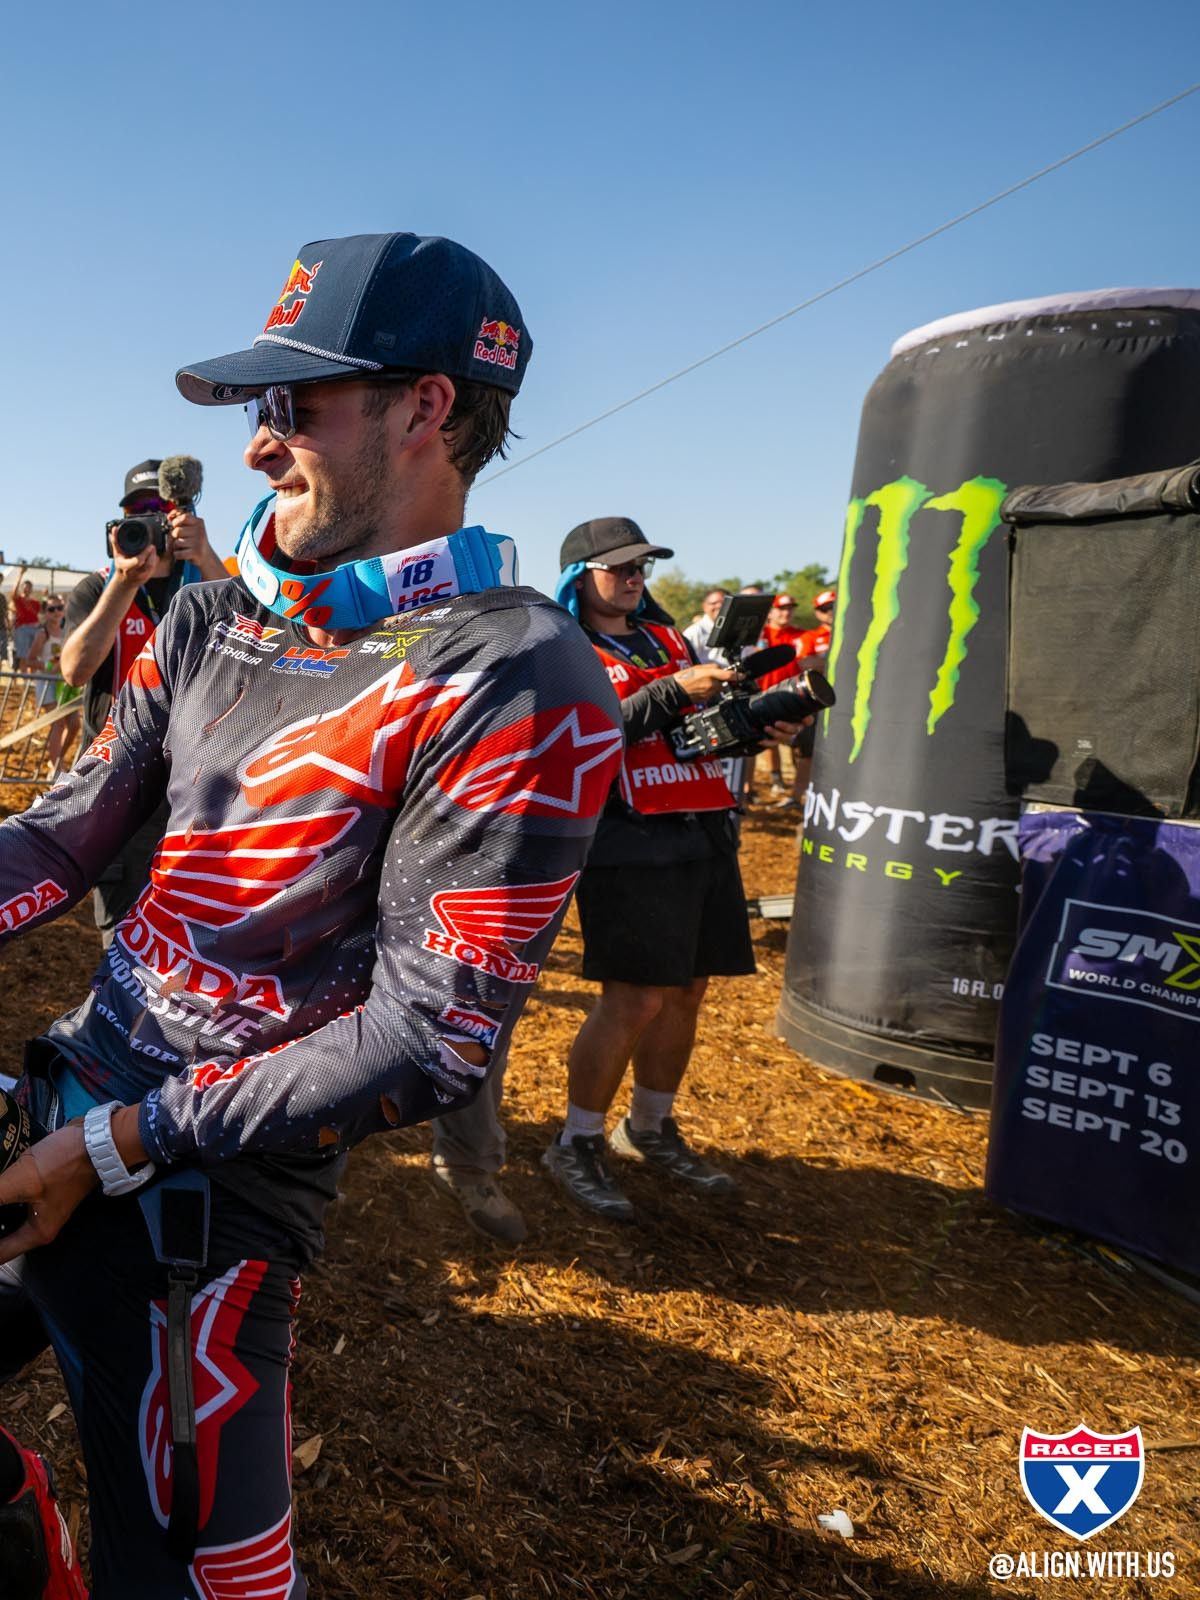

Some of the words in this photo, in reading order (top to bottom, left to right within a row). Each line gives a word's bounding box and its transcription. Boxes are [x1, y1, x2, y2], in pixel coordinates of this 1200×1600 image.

[473, 340, 499, 363] Red
[496, 346, 518, 370] Bull
[401, 559, 435, 589] 18
[397, 581, 453, 612] HRC
[126, 618, 145, 635] 20
[220, 645, 263, 666] SHOWA
[272, 646, 351, 674] HRC
[632, 762, 700, 789] FRONT
[115, 903, 293, 1024] ONDA
[421, 928, 538, 984] HONDA
[952, 977, 970, 996] 16
[1068, 967, 1137, 990] WORLD
[1031, 1033, 1139, 1075] SEPT
[1148, 1062, 1173, 1087] 6
[1026, 1065, 1135, 1108] SEPT
[1144, 1094, 1182, 1126] 13
[3, 1123, 17, 1151] 450
[1021, 1097, 1131, 1143] SEPT
[1140, 1129, 1189, 1164] 20
